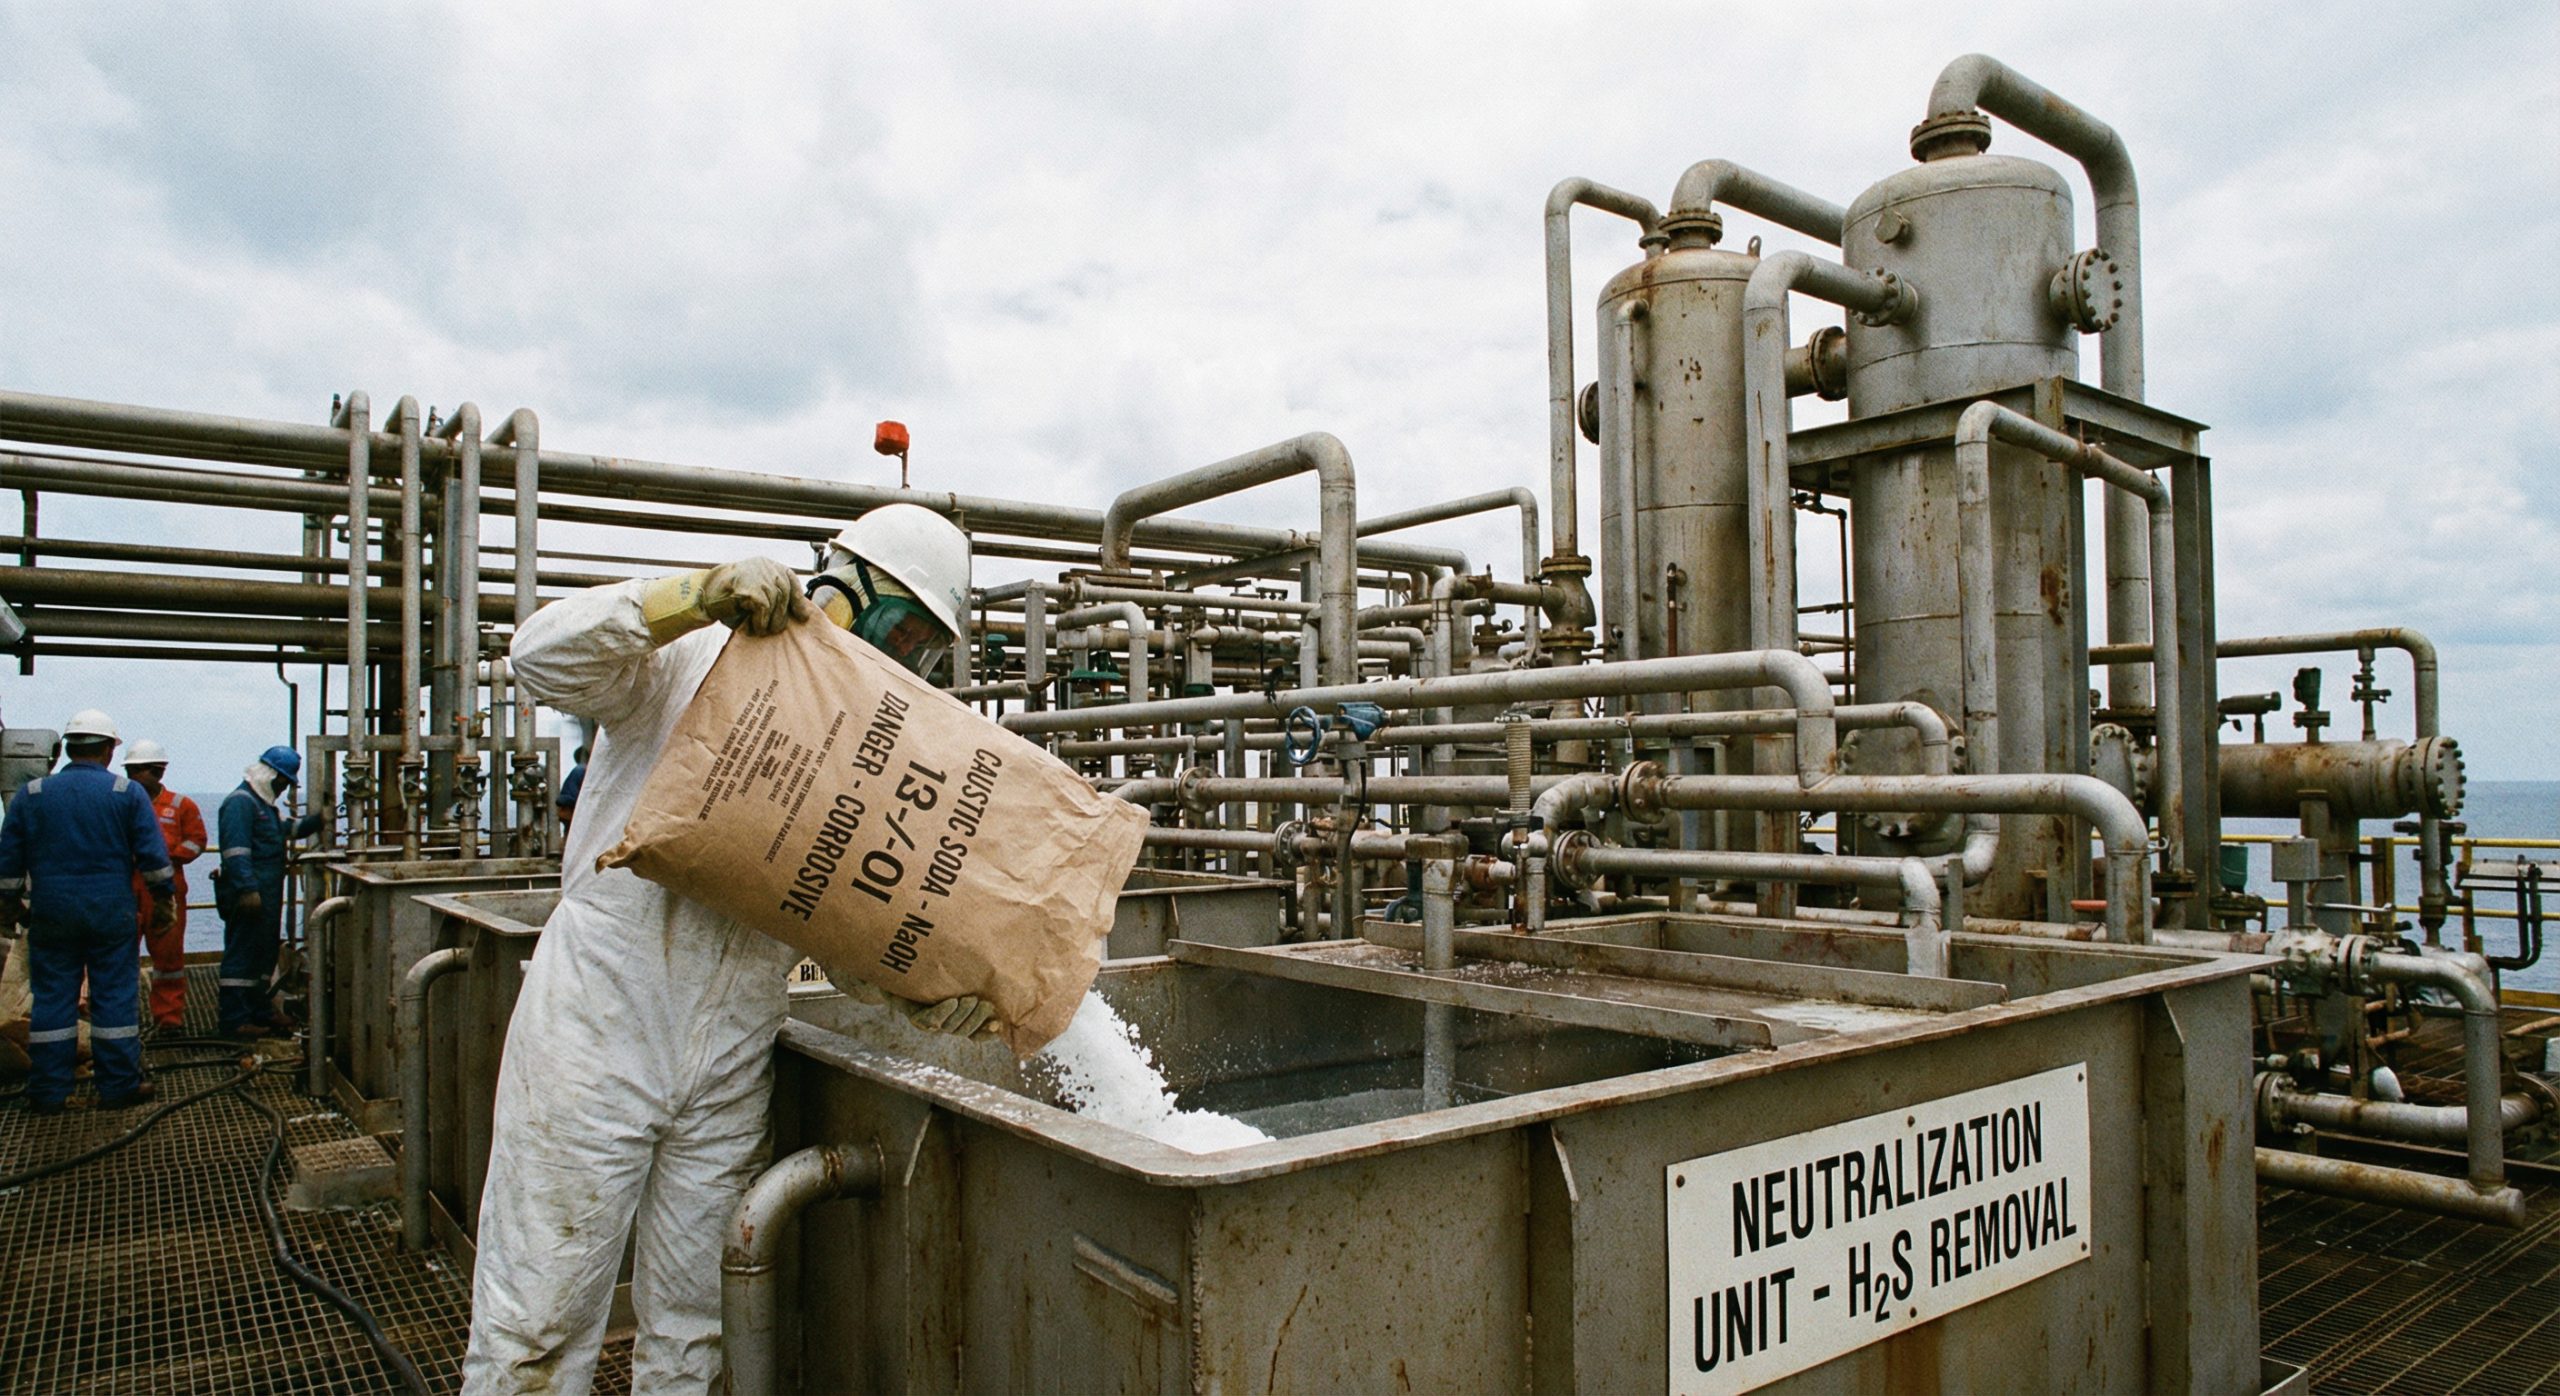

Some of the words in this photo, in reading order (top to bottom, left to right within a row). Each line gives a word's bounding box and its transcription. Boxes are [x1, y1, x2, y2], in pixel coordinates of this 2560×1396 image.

[852, 690, 910, 777] DANGER
[948, 748, 1003, 837] CAUSTIC
[779, 793, 866, 922] CORROSIVE
[919, 835, 968, 897] SODA
[879, 912, 935, 974] NaOH
[1732, 1101, 2042, 1258] NEUTRALIZATION
[1694, 1267, 1795, 1373] UNIT
[1813, 1284, 1830, 1302] -
[1849, 1230, 1914, 1324] H2S
[1931, 1176, 2077, 1288] REMOVAL
